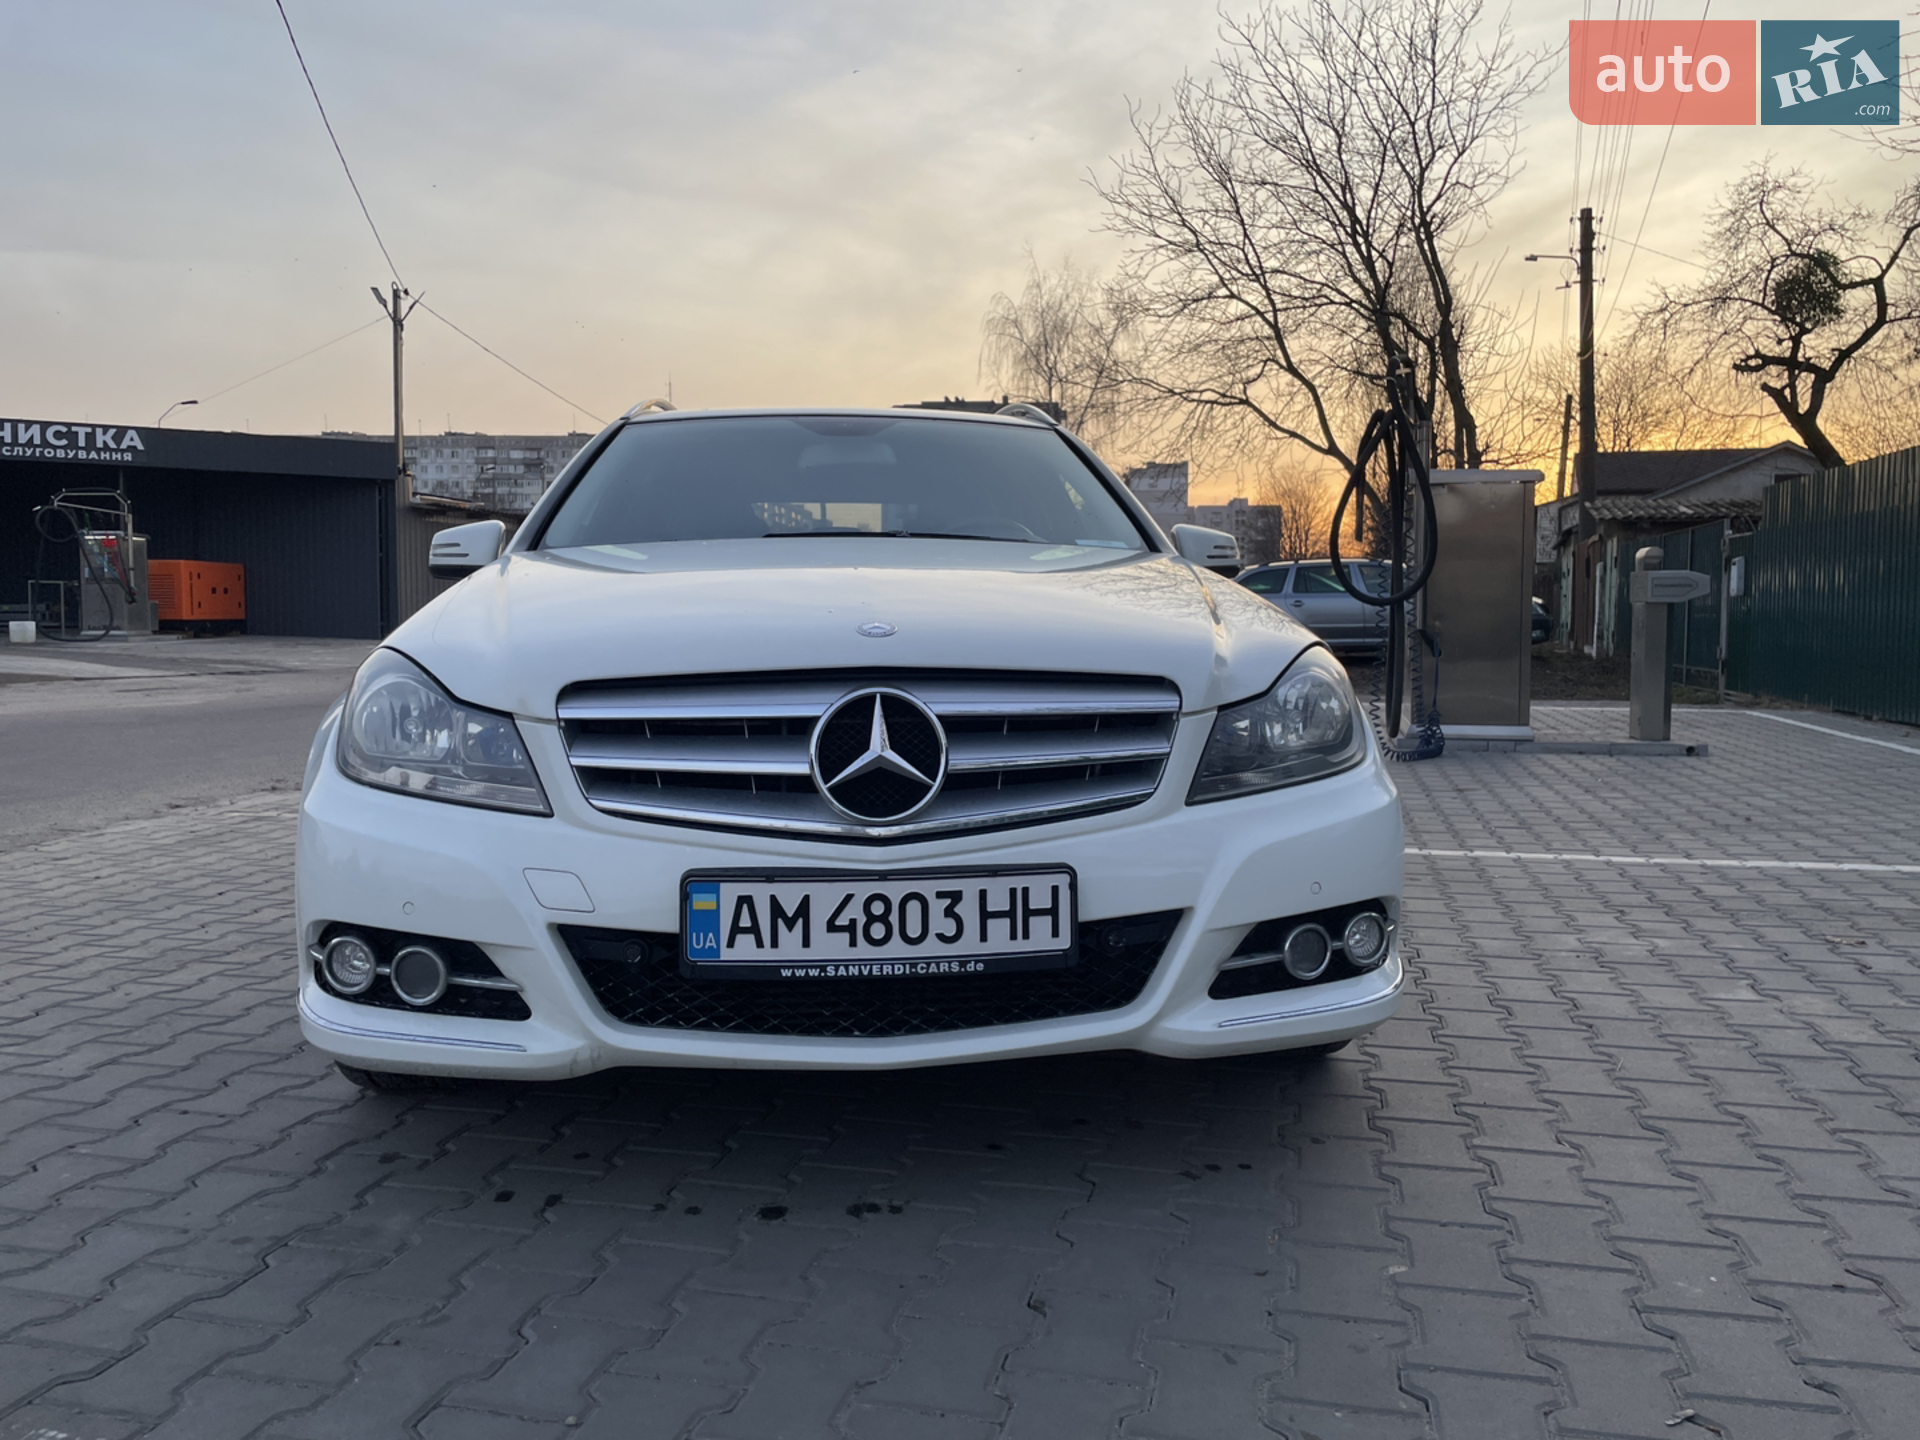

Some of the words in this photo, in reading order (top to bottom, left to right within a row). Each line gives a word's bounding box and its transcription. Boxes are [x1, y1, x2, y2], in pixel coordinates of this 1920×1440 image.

[726, 894, 811, 949] AM
[826, 890, 964, 948] 4803
[979, 885, 1059, 943] HH
[692, 932, 717, 949] UA
[780, 961, 985, 977] www.SANVERDI-CARS.de
